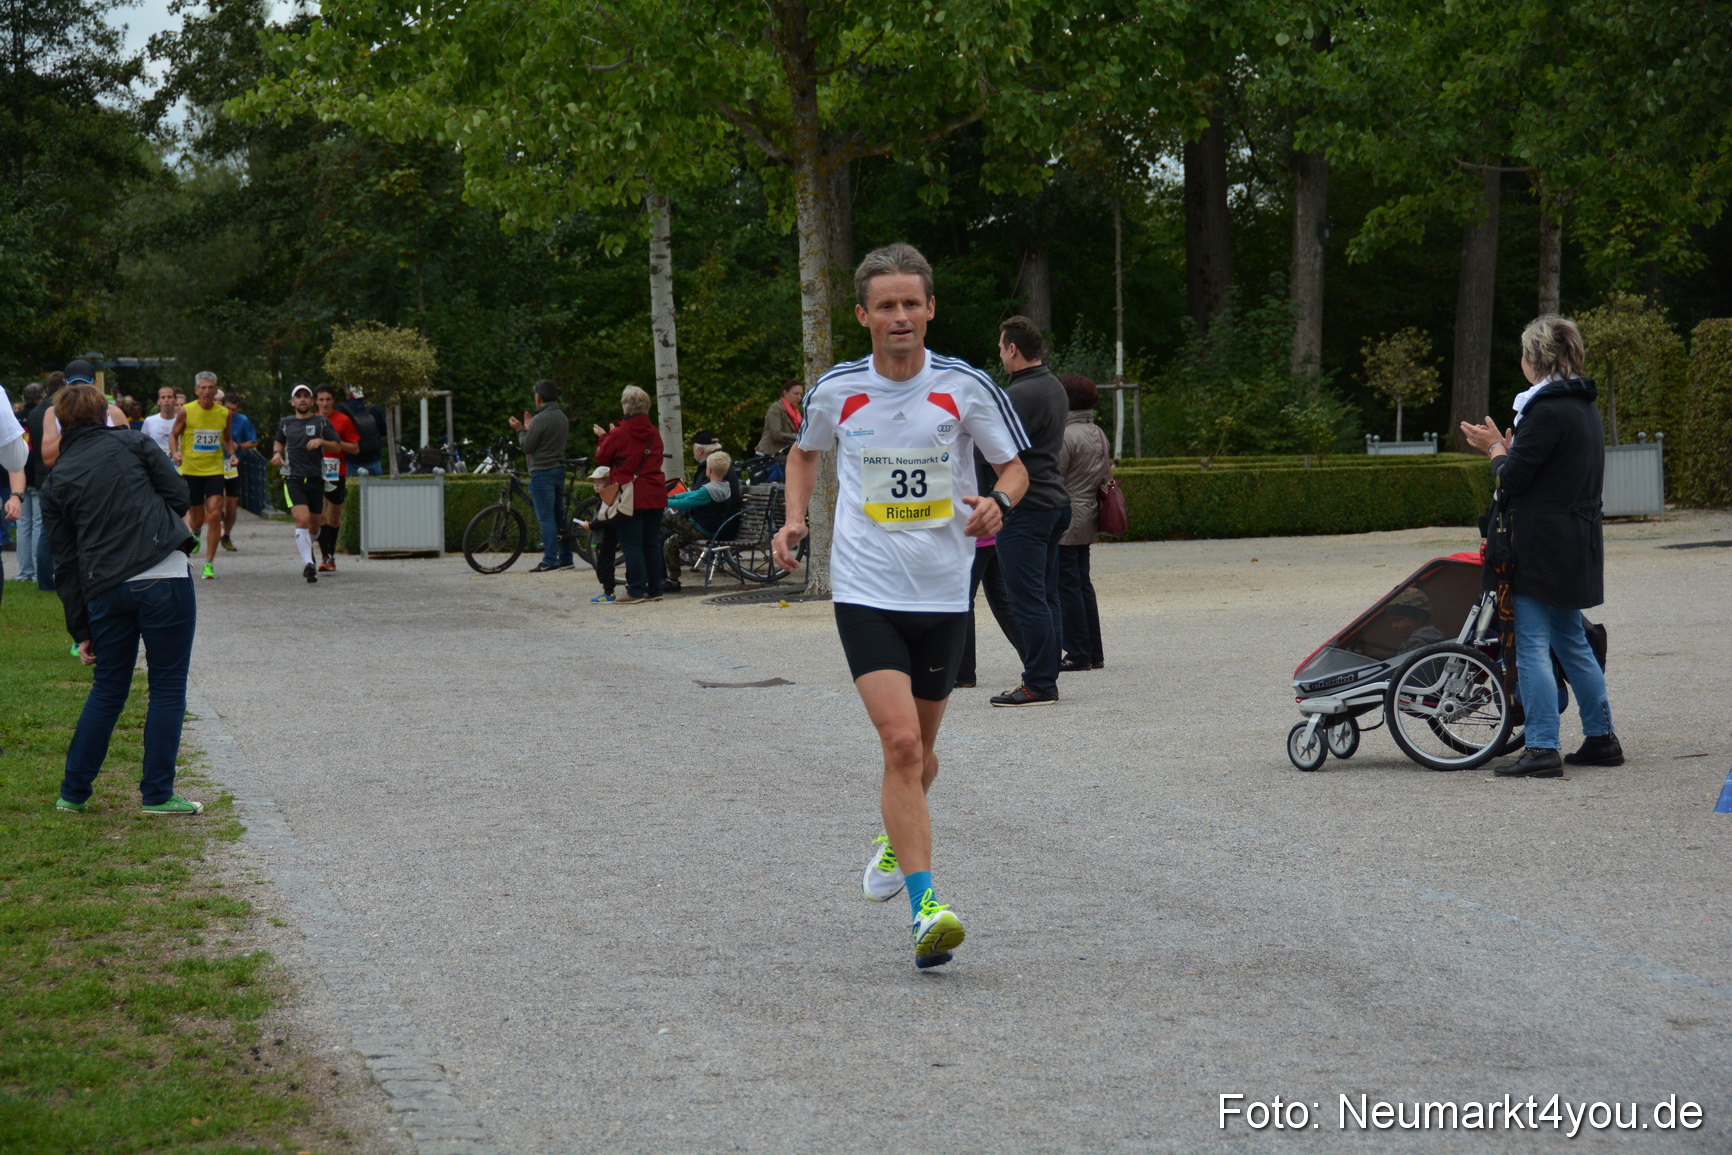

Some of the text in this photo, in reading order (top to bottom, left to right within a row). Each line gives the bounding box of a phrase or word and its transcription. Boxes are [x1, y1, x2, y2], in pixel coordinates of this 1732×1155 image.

[196, 435, 219, 444] 2137
[863, 456, 939, 465] PARTL Neumarkt
[891, 469, 928, 499] 33
[886, 505, 931, 519] Richard
[1311, 674, 1355, 689] chariot
